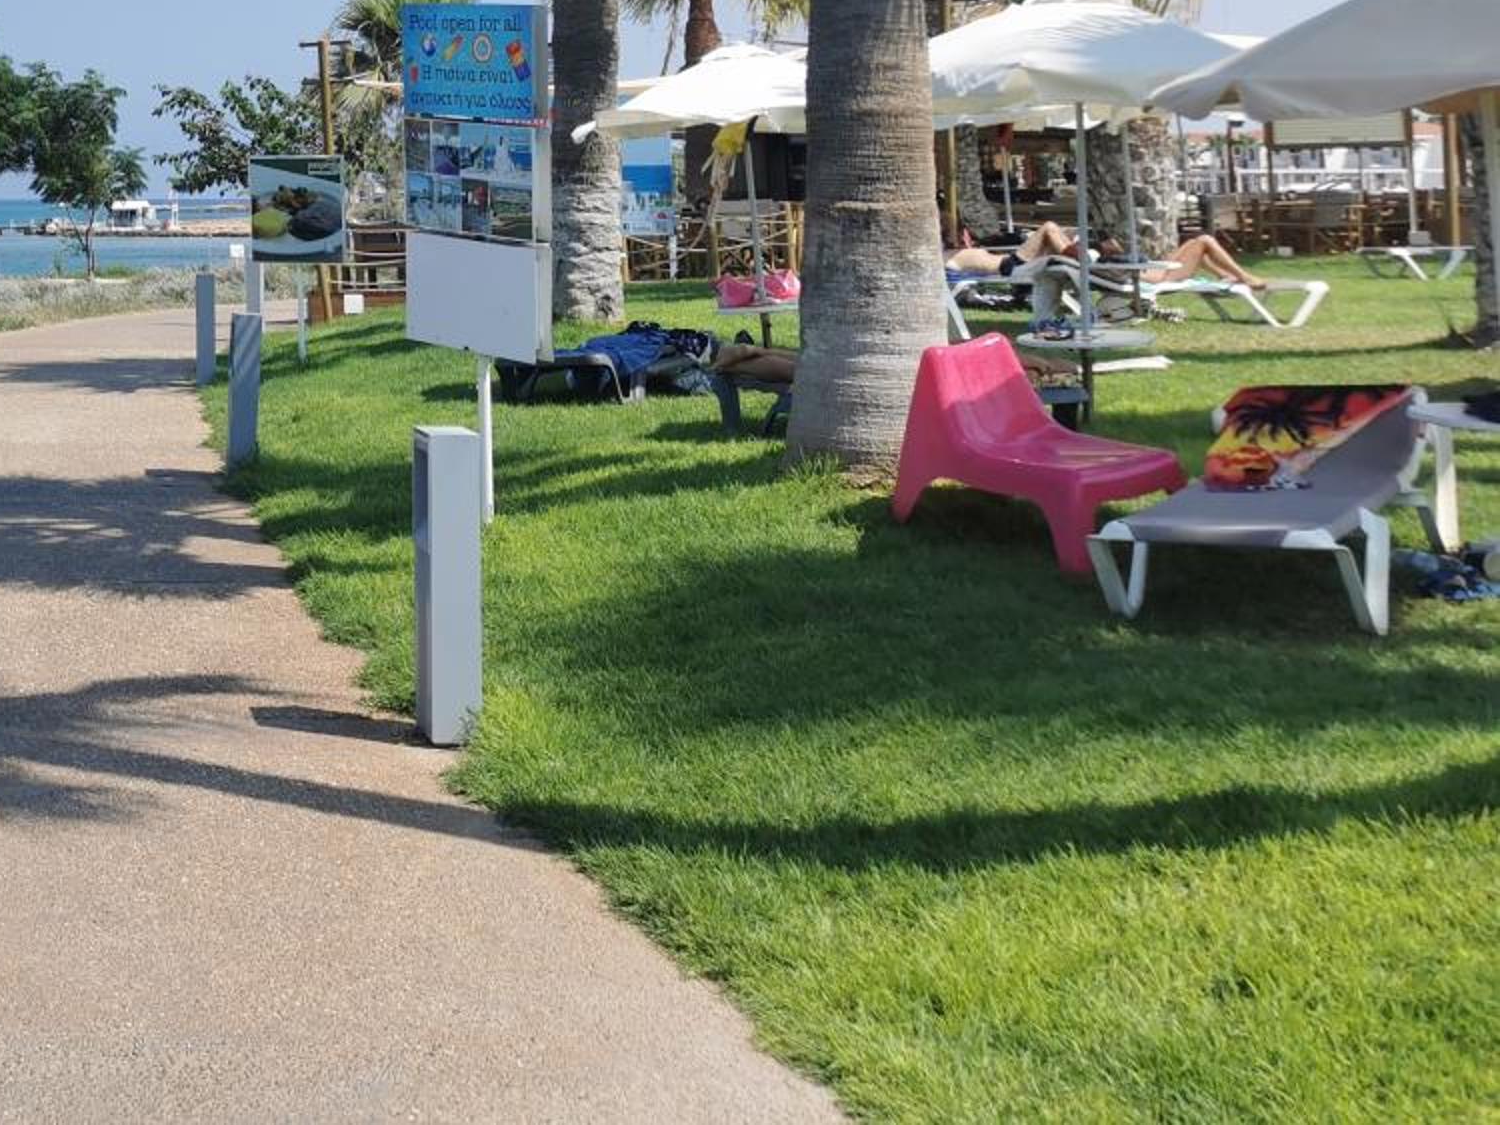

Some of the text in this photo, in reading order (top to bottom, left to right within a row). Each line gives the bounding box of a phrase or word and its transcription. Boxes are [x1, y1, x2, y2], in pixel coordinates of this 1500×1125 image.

[409, 12, 523, 33] Pool open for all
